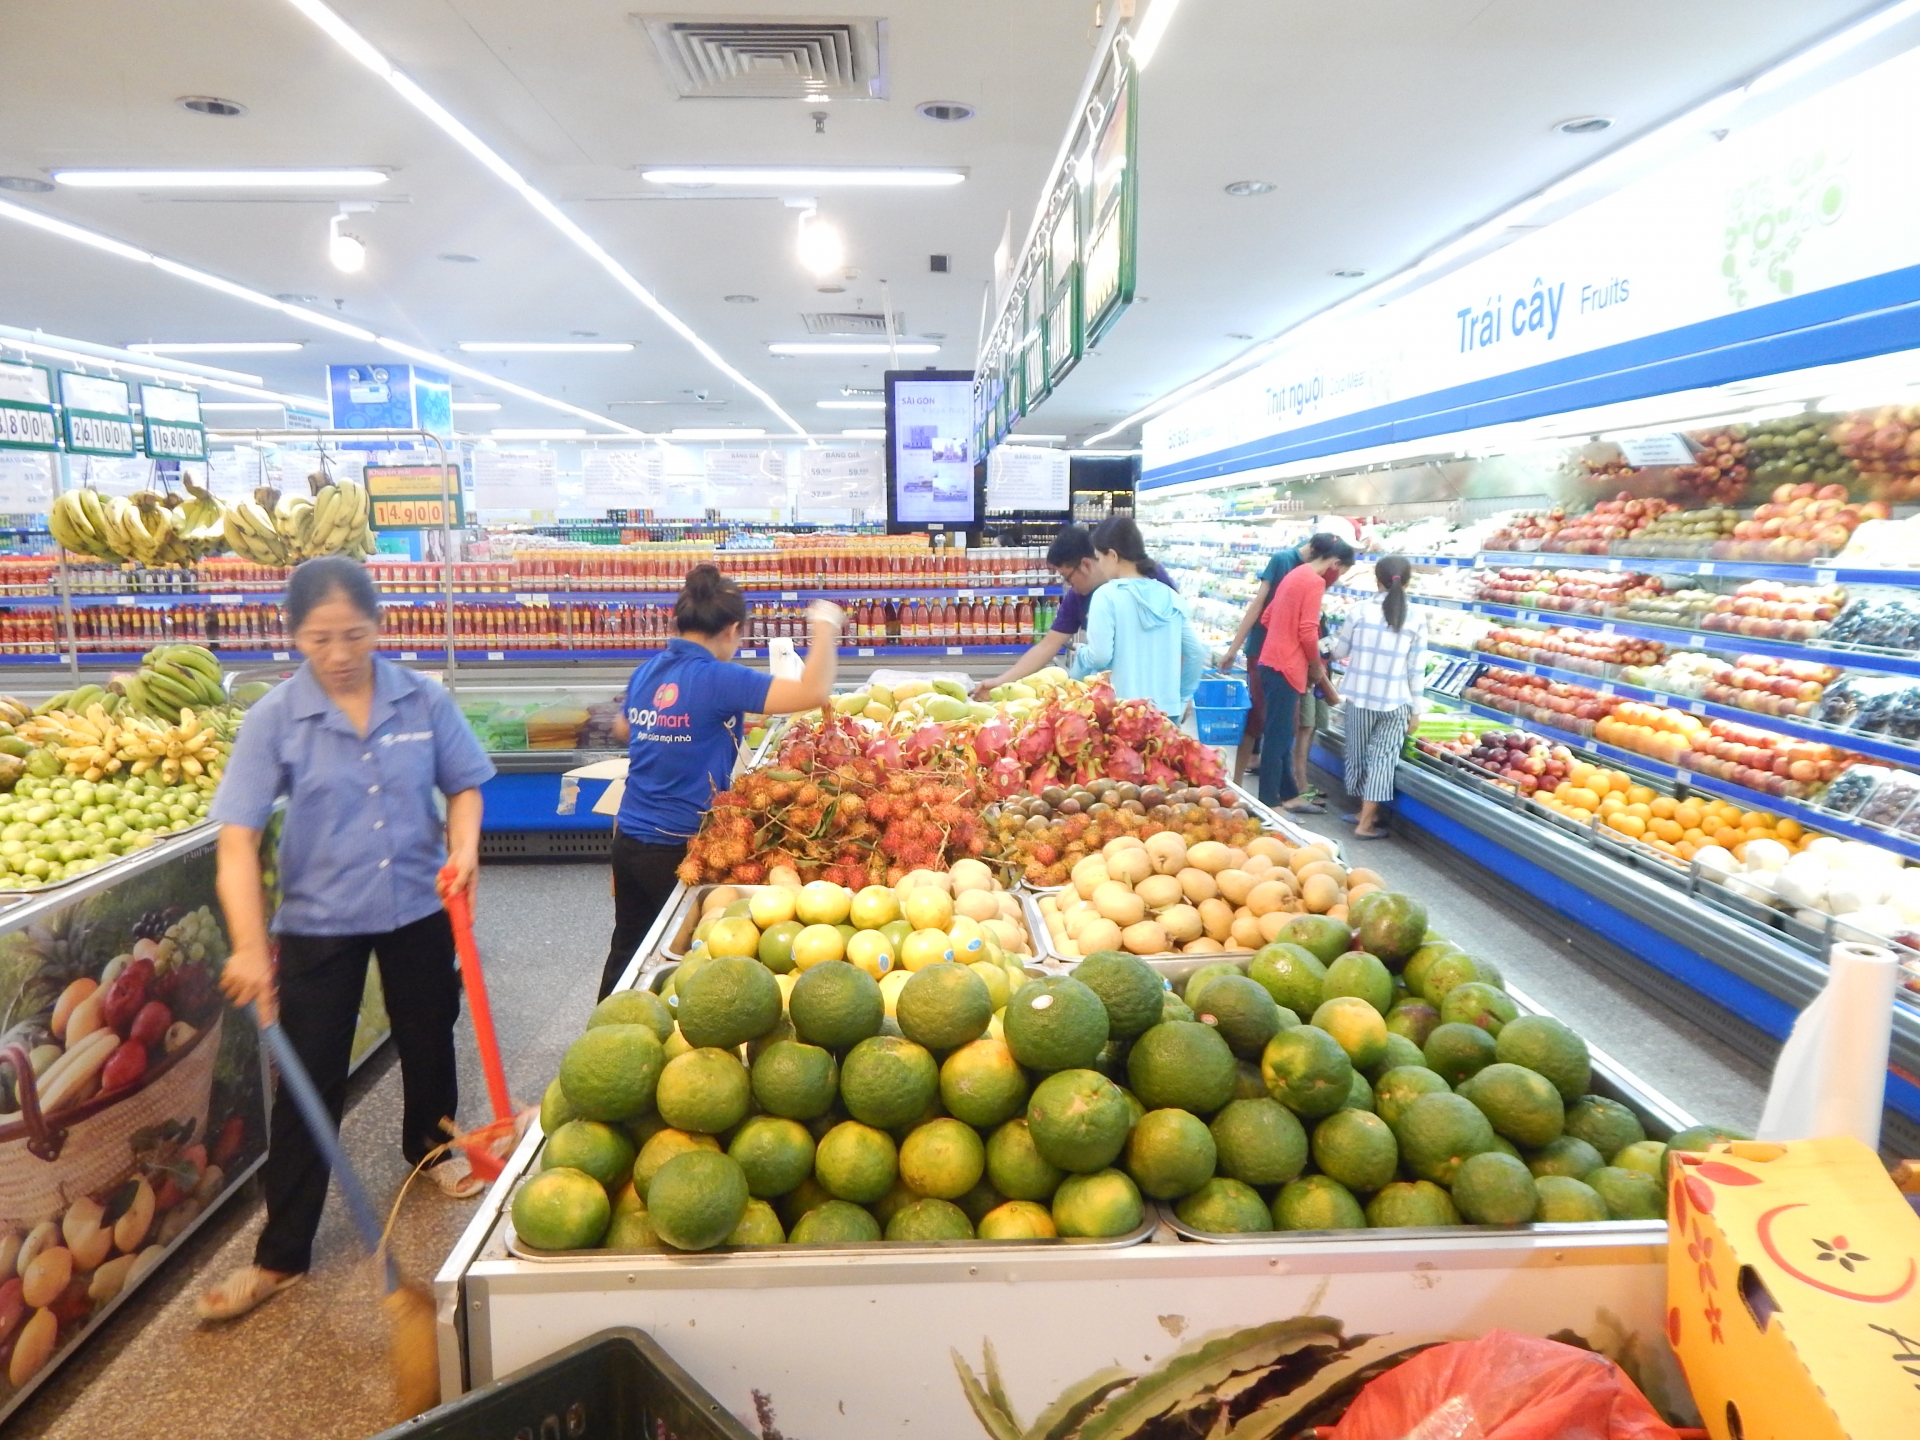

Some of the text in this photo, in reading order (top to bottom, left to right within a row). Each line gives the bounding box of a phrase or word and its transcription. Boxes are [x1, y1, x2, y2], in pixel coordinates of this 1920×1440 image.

[1457, 276, 1630, 353] Trái cây Fruits
[901, 395, 936, 405] SÀI GÒN
[74, 421, 121, 445] 26.100
[153, 429, 193, 451] 19.800
[377, 503, 441, 522] 14.900
[674, 733, 692, 743] nhà
